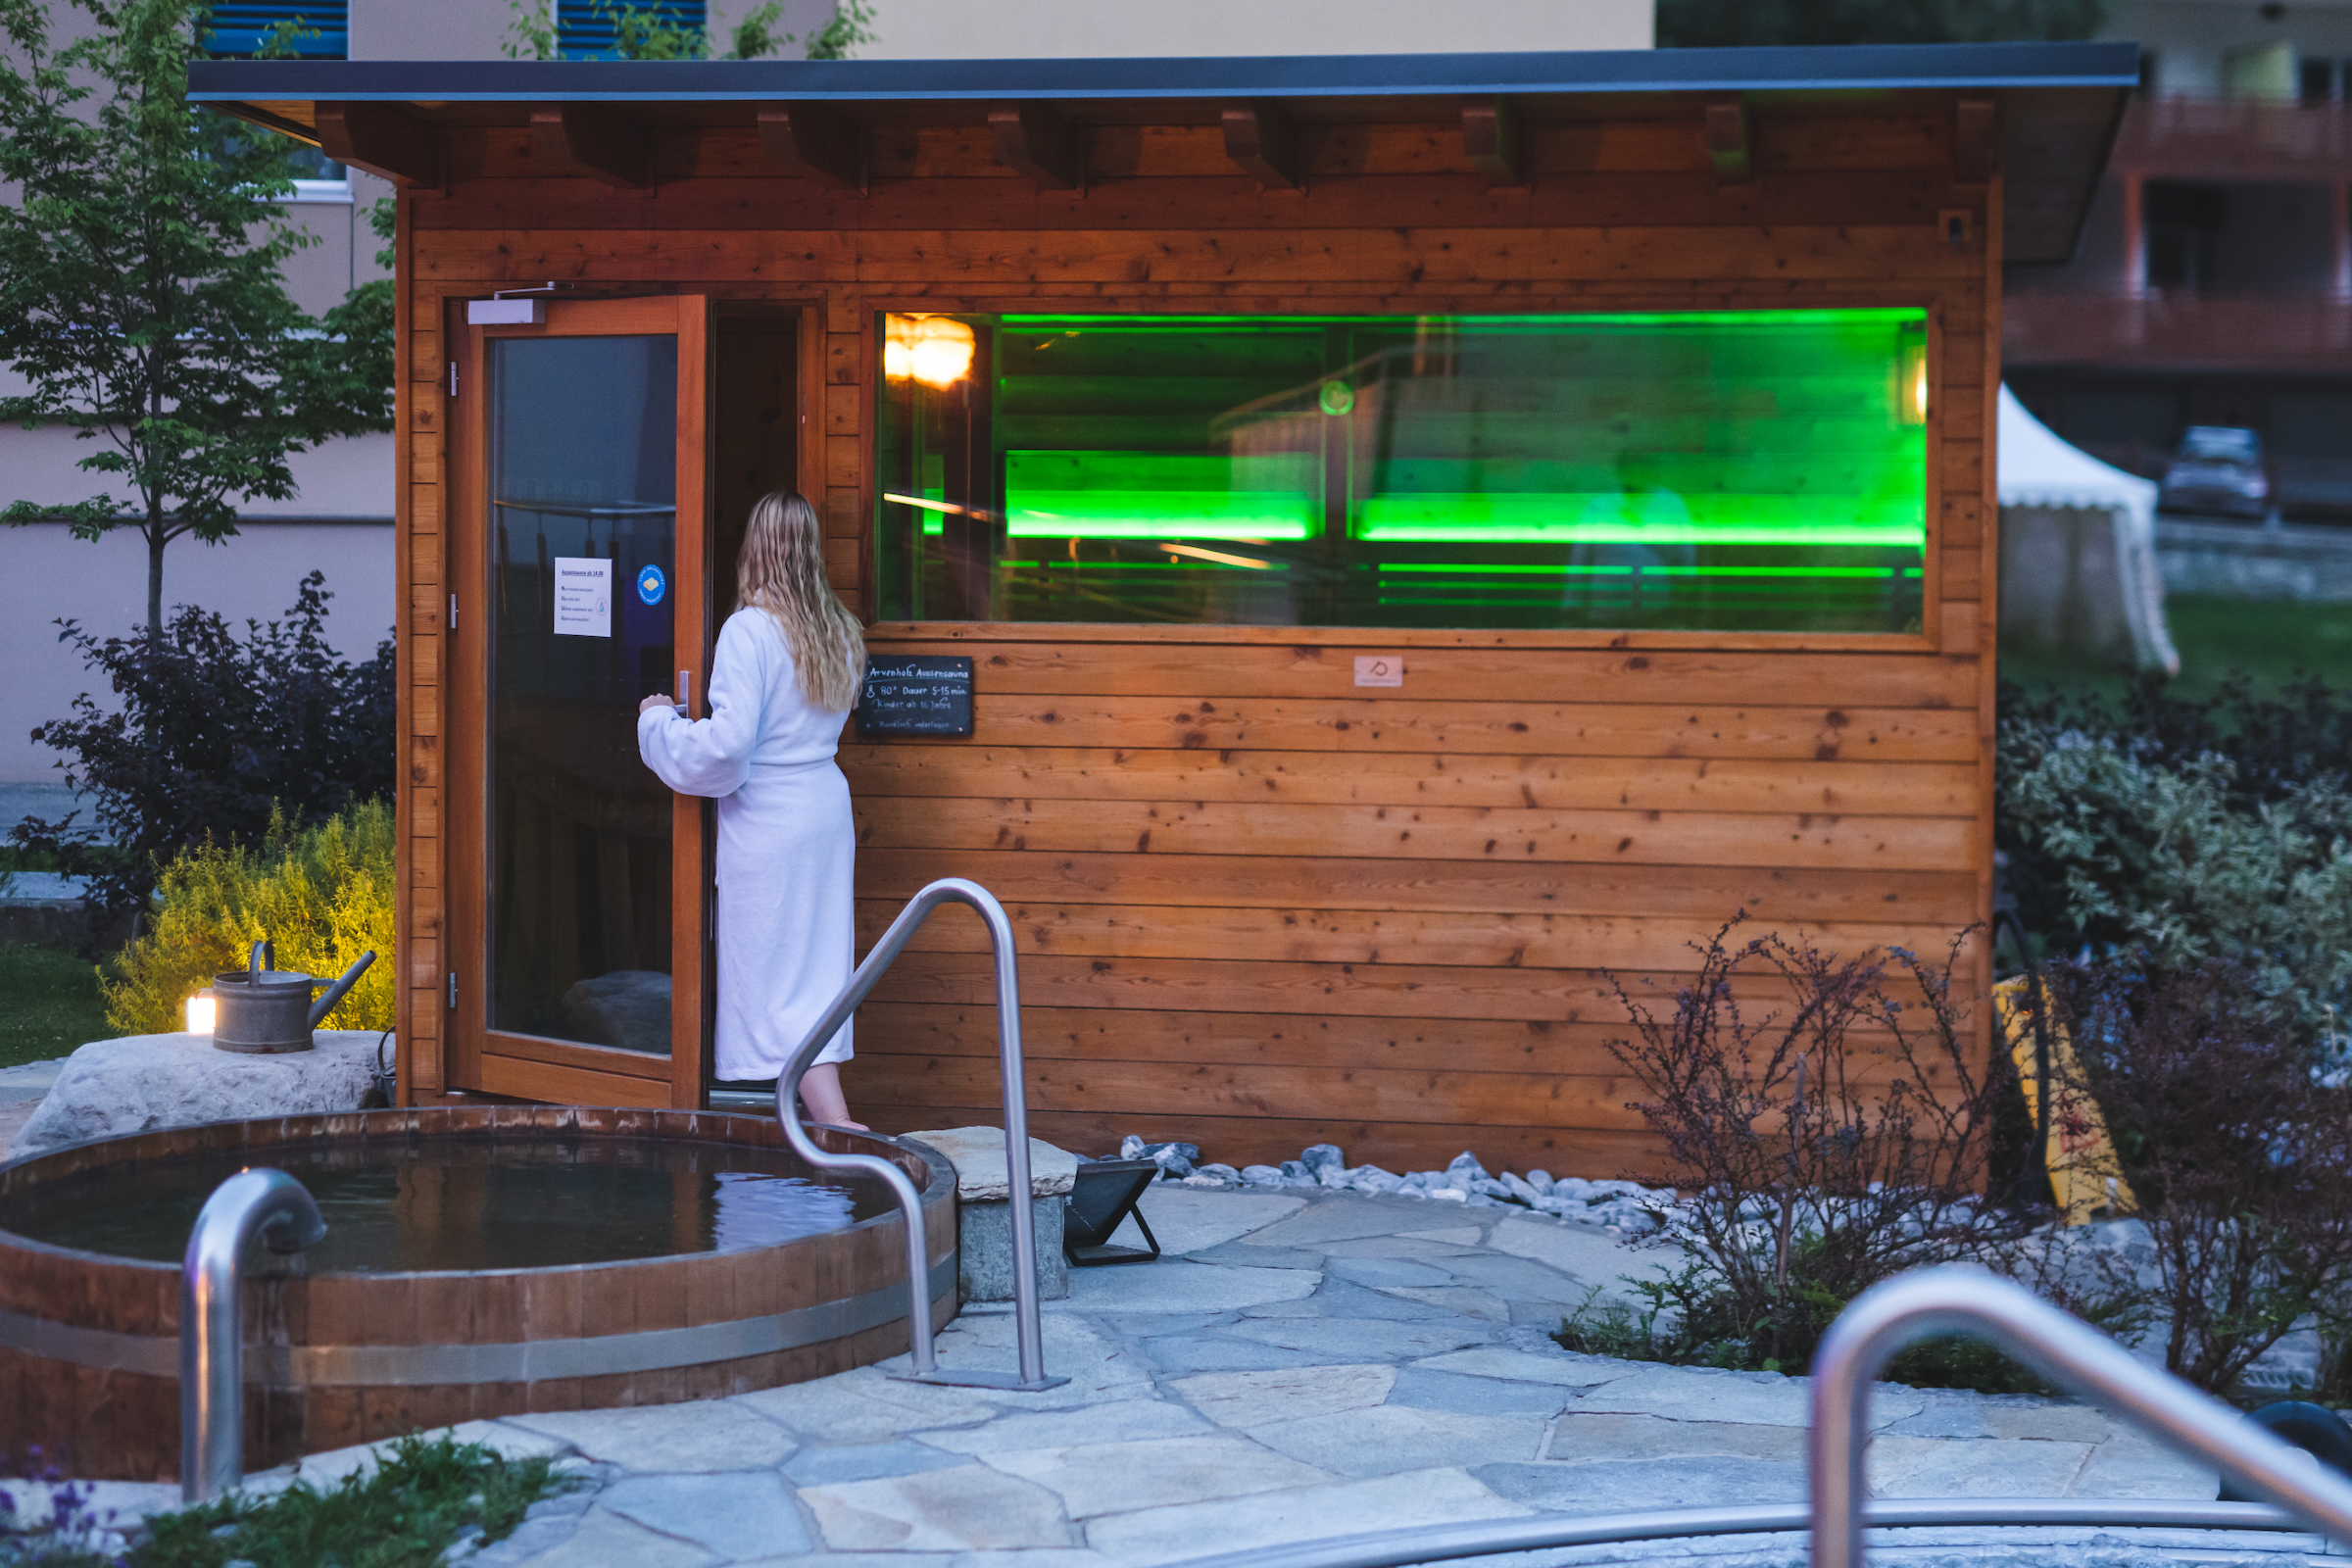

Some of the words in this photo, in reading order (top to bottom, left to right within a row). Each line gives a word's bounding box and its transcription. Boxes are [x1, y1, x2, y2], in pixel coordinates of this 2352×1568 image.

[866, 663, 915, 680] Arvenholz
[916, 668, 968, 678] Aussensauna
[880, 686, 897, 696] 80°
[902, 686, 927, 695] Dauer
[932, 686, 950, 696] 5-15
[871, 698, 904, 708] Kinder
[906, 700, 916, 709] ab
[930, 697, 952, 711] Jahre
